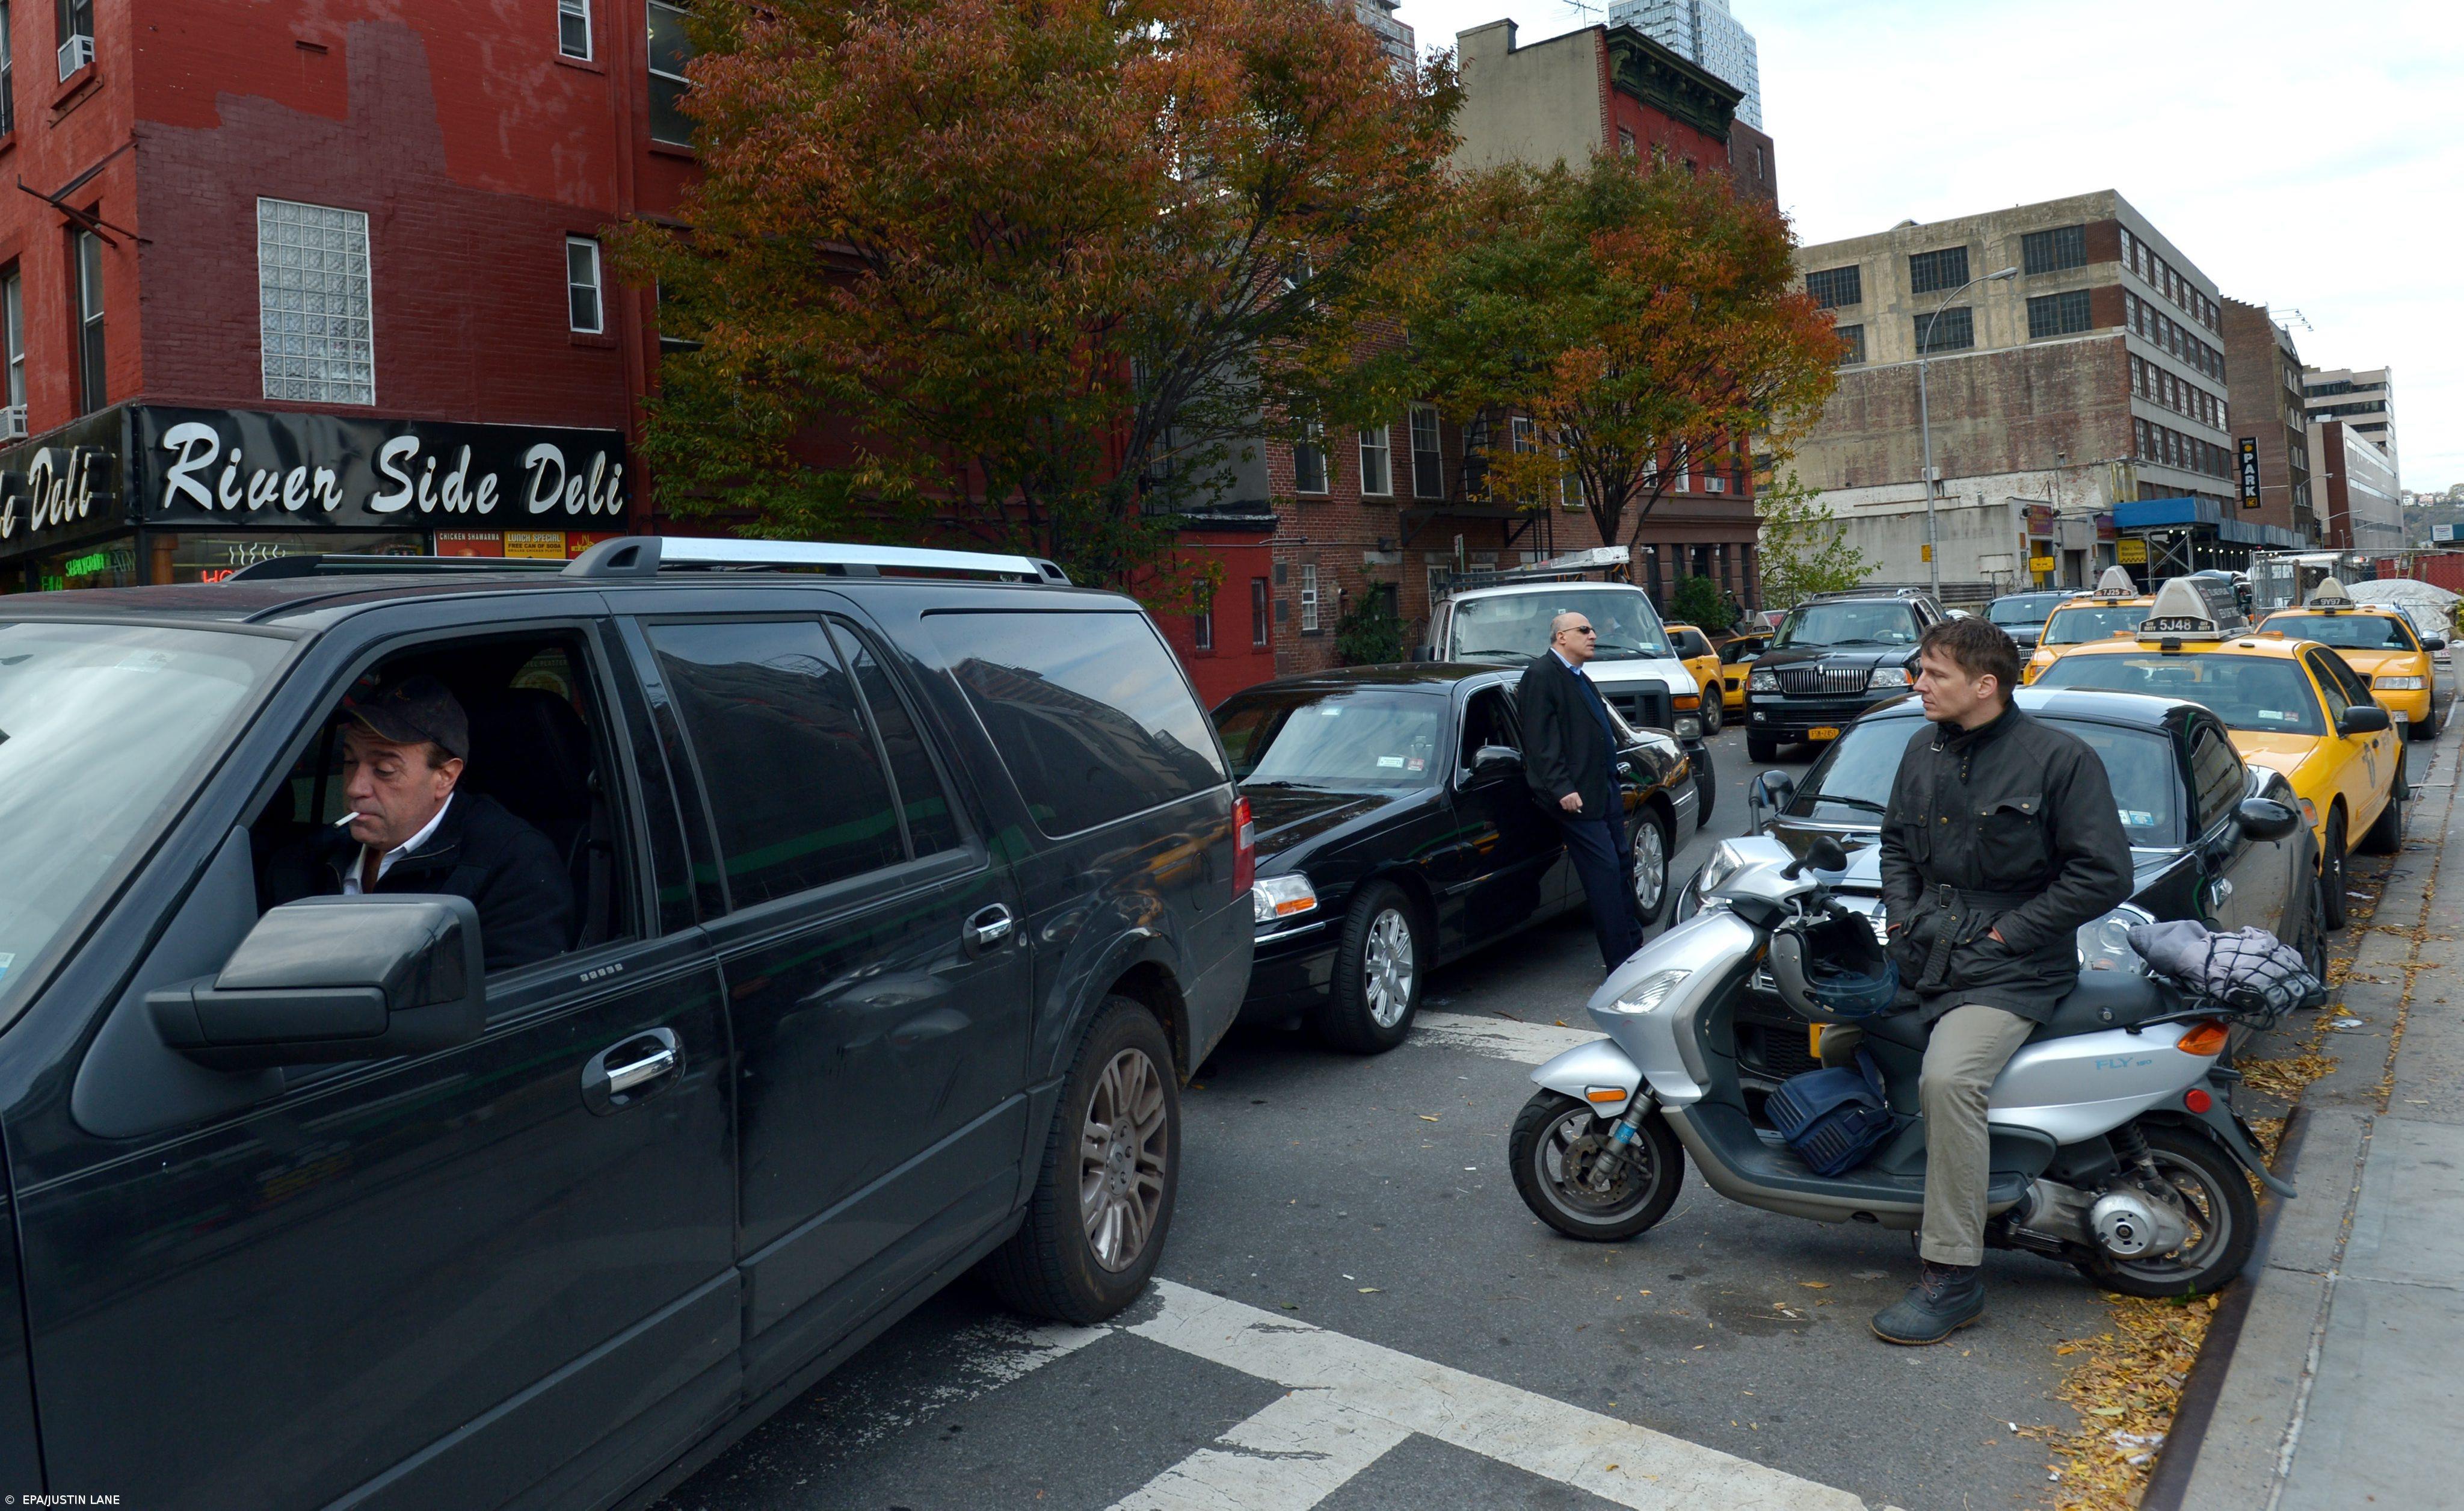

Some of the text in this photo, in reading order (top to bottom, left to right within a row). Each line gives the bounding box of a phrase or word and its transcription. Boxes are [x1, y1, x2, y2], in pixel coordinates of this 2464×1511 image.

[163, 422, 623, 515] River Side Deli
[2243, 453, 2256, 496] PARK
[28, 445, 93, 531] Deli
[467, 533, 500, 541] SHAWARMA
[508, 533, 561, 542] LUNCH SPECIAL
[2160, 619, 2191, 631] 5J48
[2095, 1057, 2133, 1070] FLY
